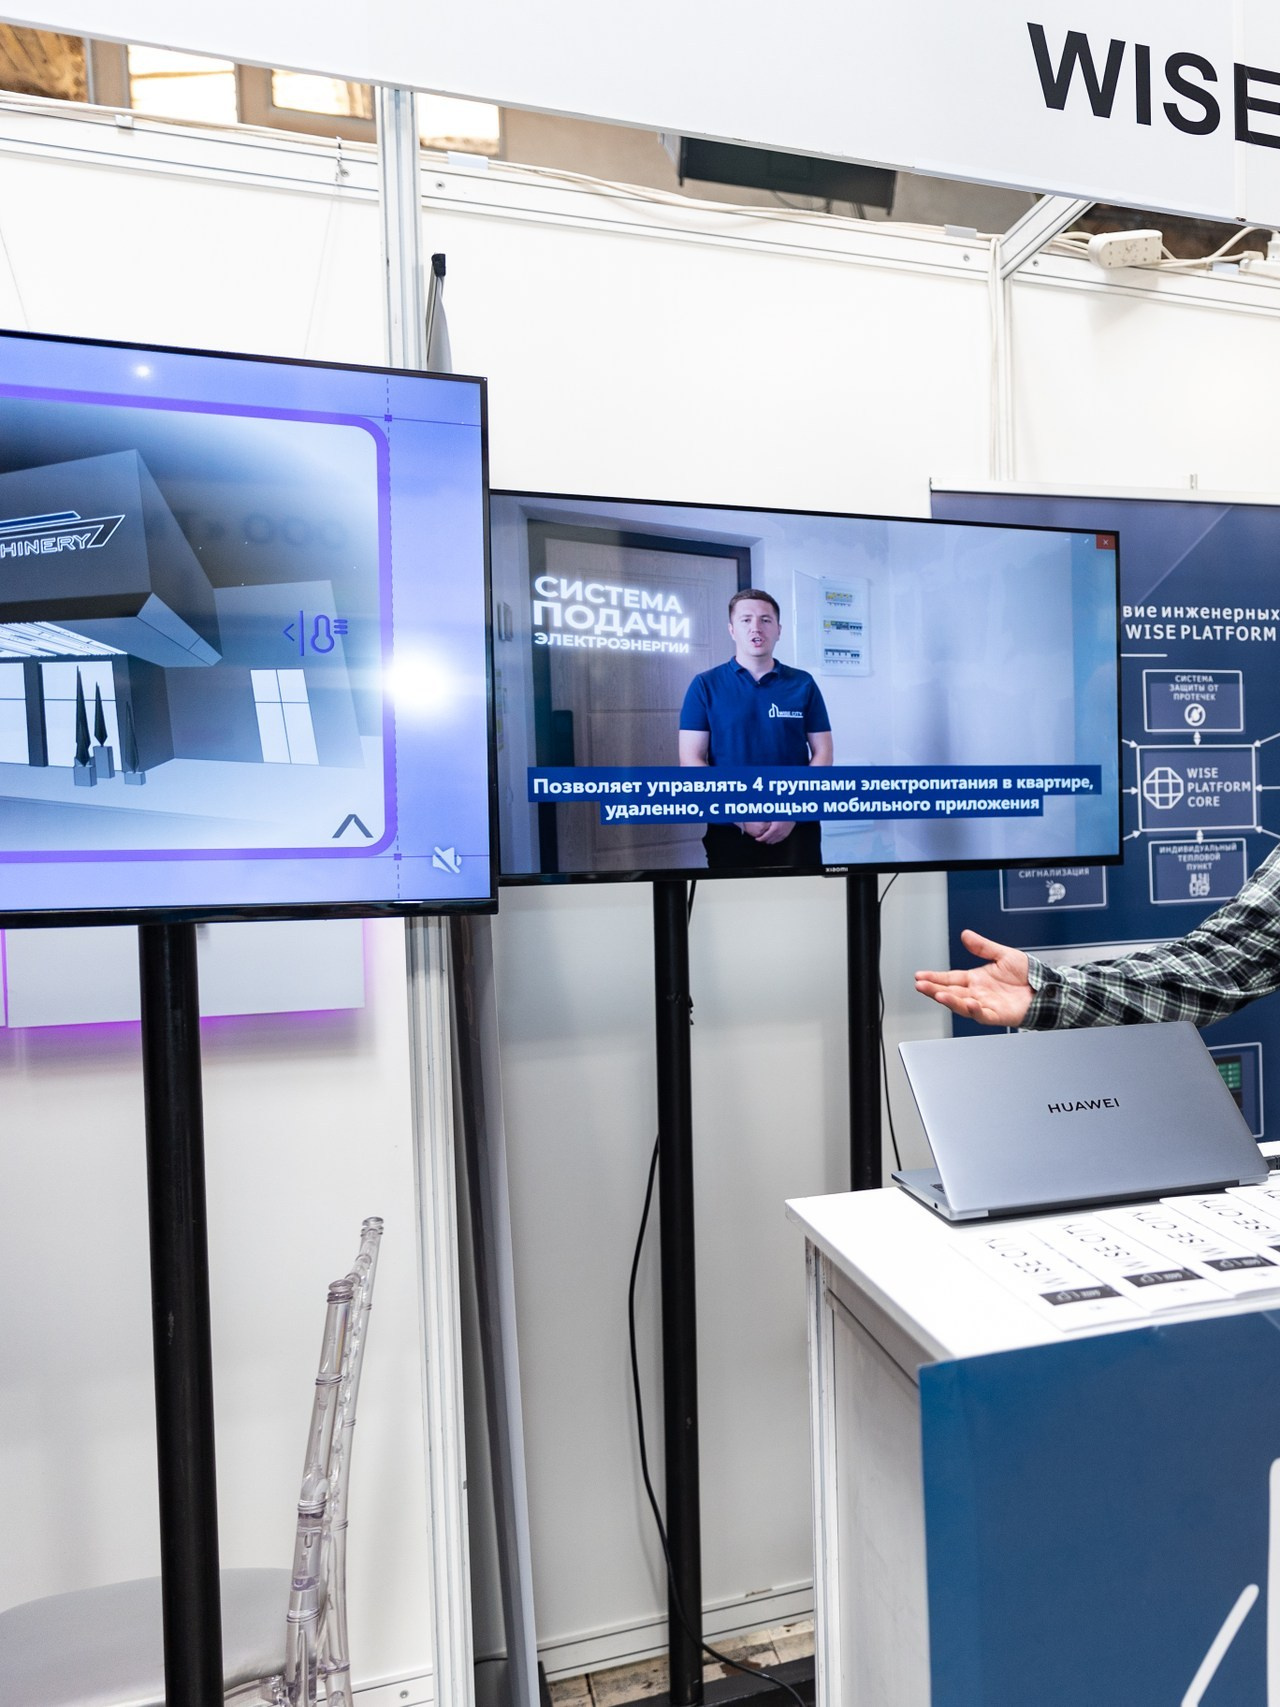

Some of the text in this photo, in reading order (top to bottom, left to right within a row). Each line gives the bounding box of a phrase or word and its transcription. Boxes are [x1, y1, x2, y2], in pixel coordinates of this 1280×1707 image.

[534, 576, 683, 614] СИСТЕМА
[533, 600, 690, 638] ПОДАЧИ
[1123, 605, 1280, 623] вие инженерных
[1125, 624, 1277, 641] WISE PLATFORM
[534, 632, 690, 653] ЭЛЕКТРОЭНЕРГИИ
[1174, 674, 1214, 683] СИСТЕМА
[1169, 684, 1219, 692] ЗАЩИТЫ ОТ
[1172, 693, 1216, 701] ПРОТЕЧЕК
[1186, 767, 1218, 778] WISE
[533, 776, 1095, 797] Позволяет управлять 4 группами электропитания в квартире,
[1187, 781, 1251, 793] PLATFORM
[1187, 796, 1221, 807] CORE
[605, 797, 1040, 820] удаленно, с помощью мобильного приложения
[1159, 843, 1237, 854] ИНДИВИДУАЛЬНЫЙ
[1178, 853, 1221, 862] ТЕПЛОВОЙ
[1186, 862, 1212, 871] ПУНКТ
[1018, 867, 1090, 879] СИГНАЛИЗАЦИЯ
[1048, 1098, 1120, 1113] HUAWEI
